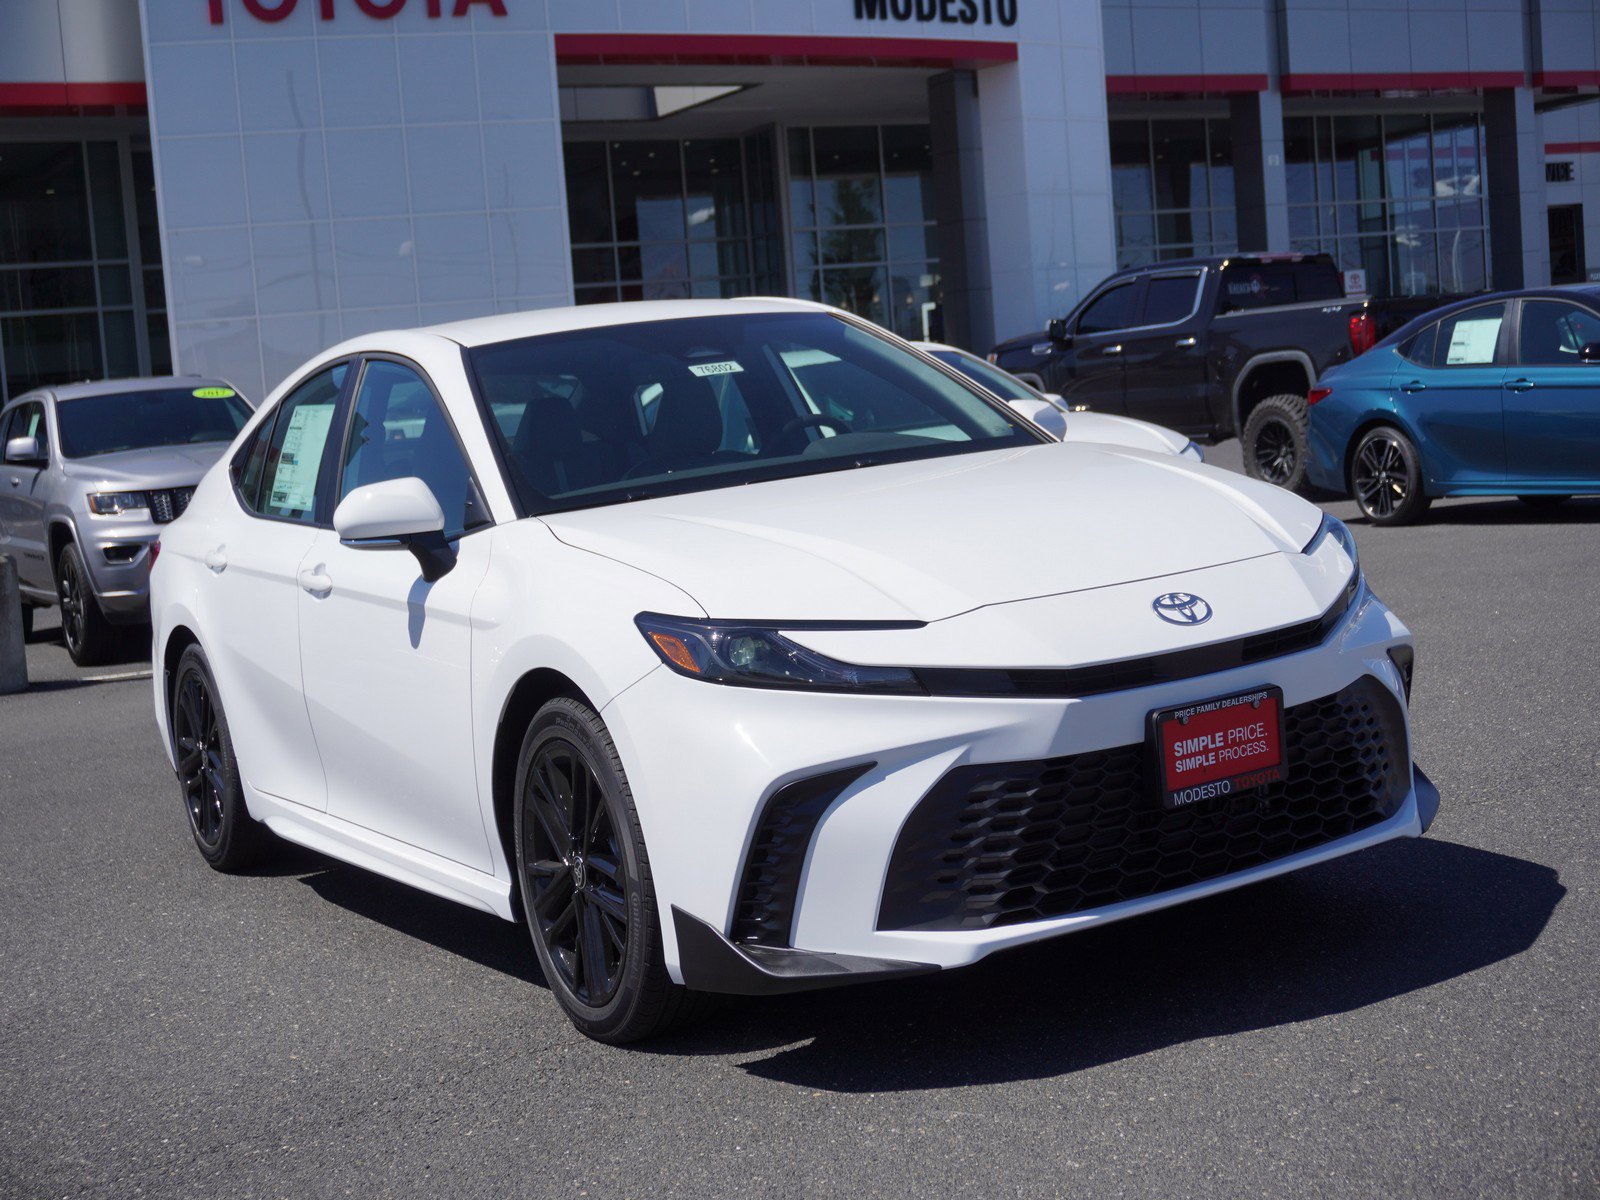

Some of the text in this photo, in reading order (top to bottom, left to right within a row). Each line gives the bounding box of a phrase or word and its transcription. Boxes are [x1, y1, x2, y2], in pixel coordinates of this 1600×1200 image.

[1175, 692, 1268, 718] PRICE FAMILY DEALERSHIPS
[1174, 722, 1268, 757] SIMPLE PRICE.
[1175, 740, 1269, 773] SIMPLE PROCESS.
[1174, 768, 1280, 805] MODESTO TOYOTA
